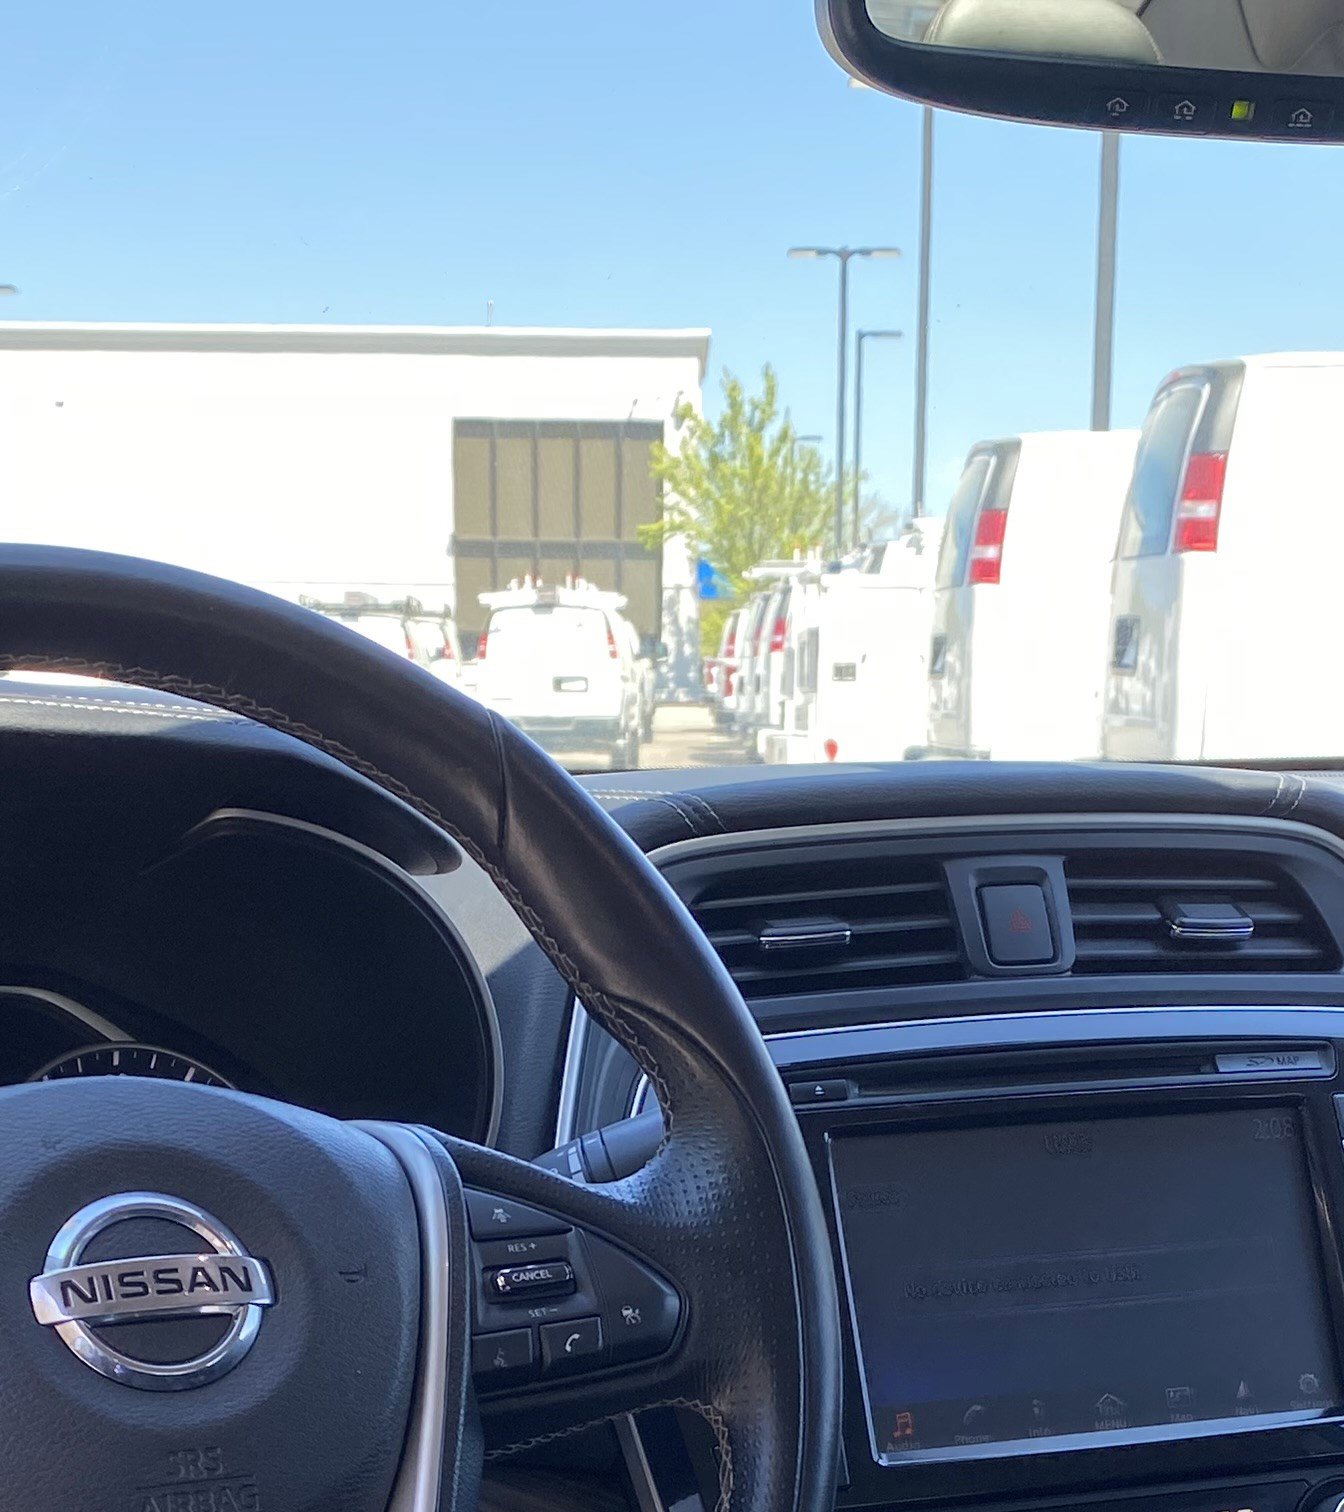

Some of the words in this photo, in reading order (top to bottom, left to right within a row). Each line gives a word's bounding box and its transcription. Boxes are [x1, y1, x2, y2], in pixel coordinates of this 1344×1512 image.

[1276, 1056, 1300, 1066] MAP
[507, 1242, 527, 1253] RES
[511, 1268, 553, 1282] CANCEL
[59, 1265, 254, 1308] NISSAN
[528, 1307, 548, 1318] SET
